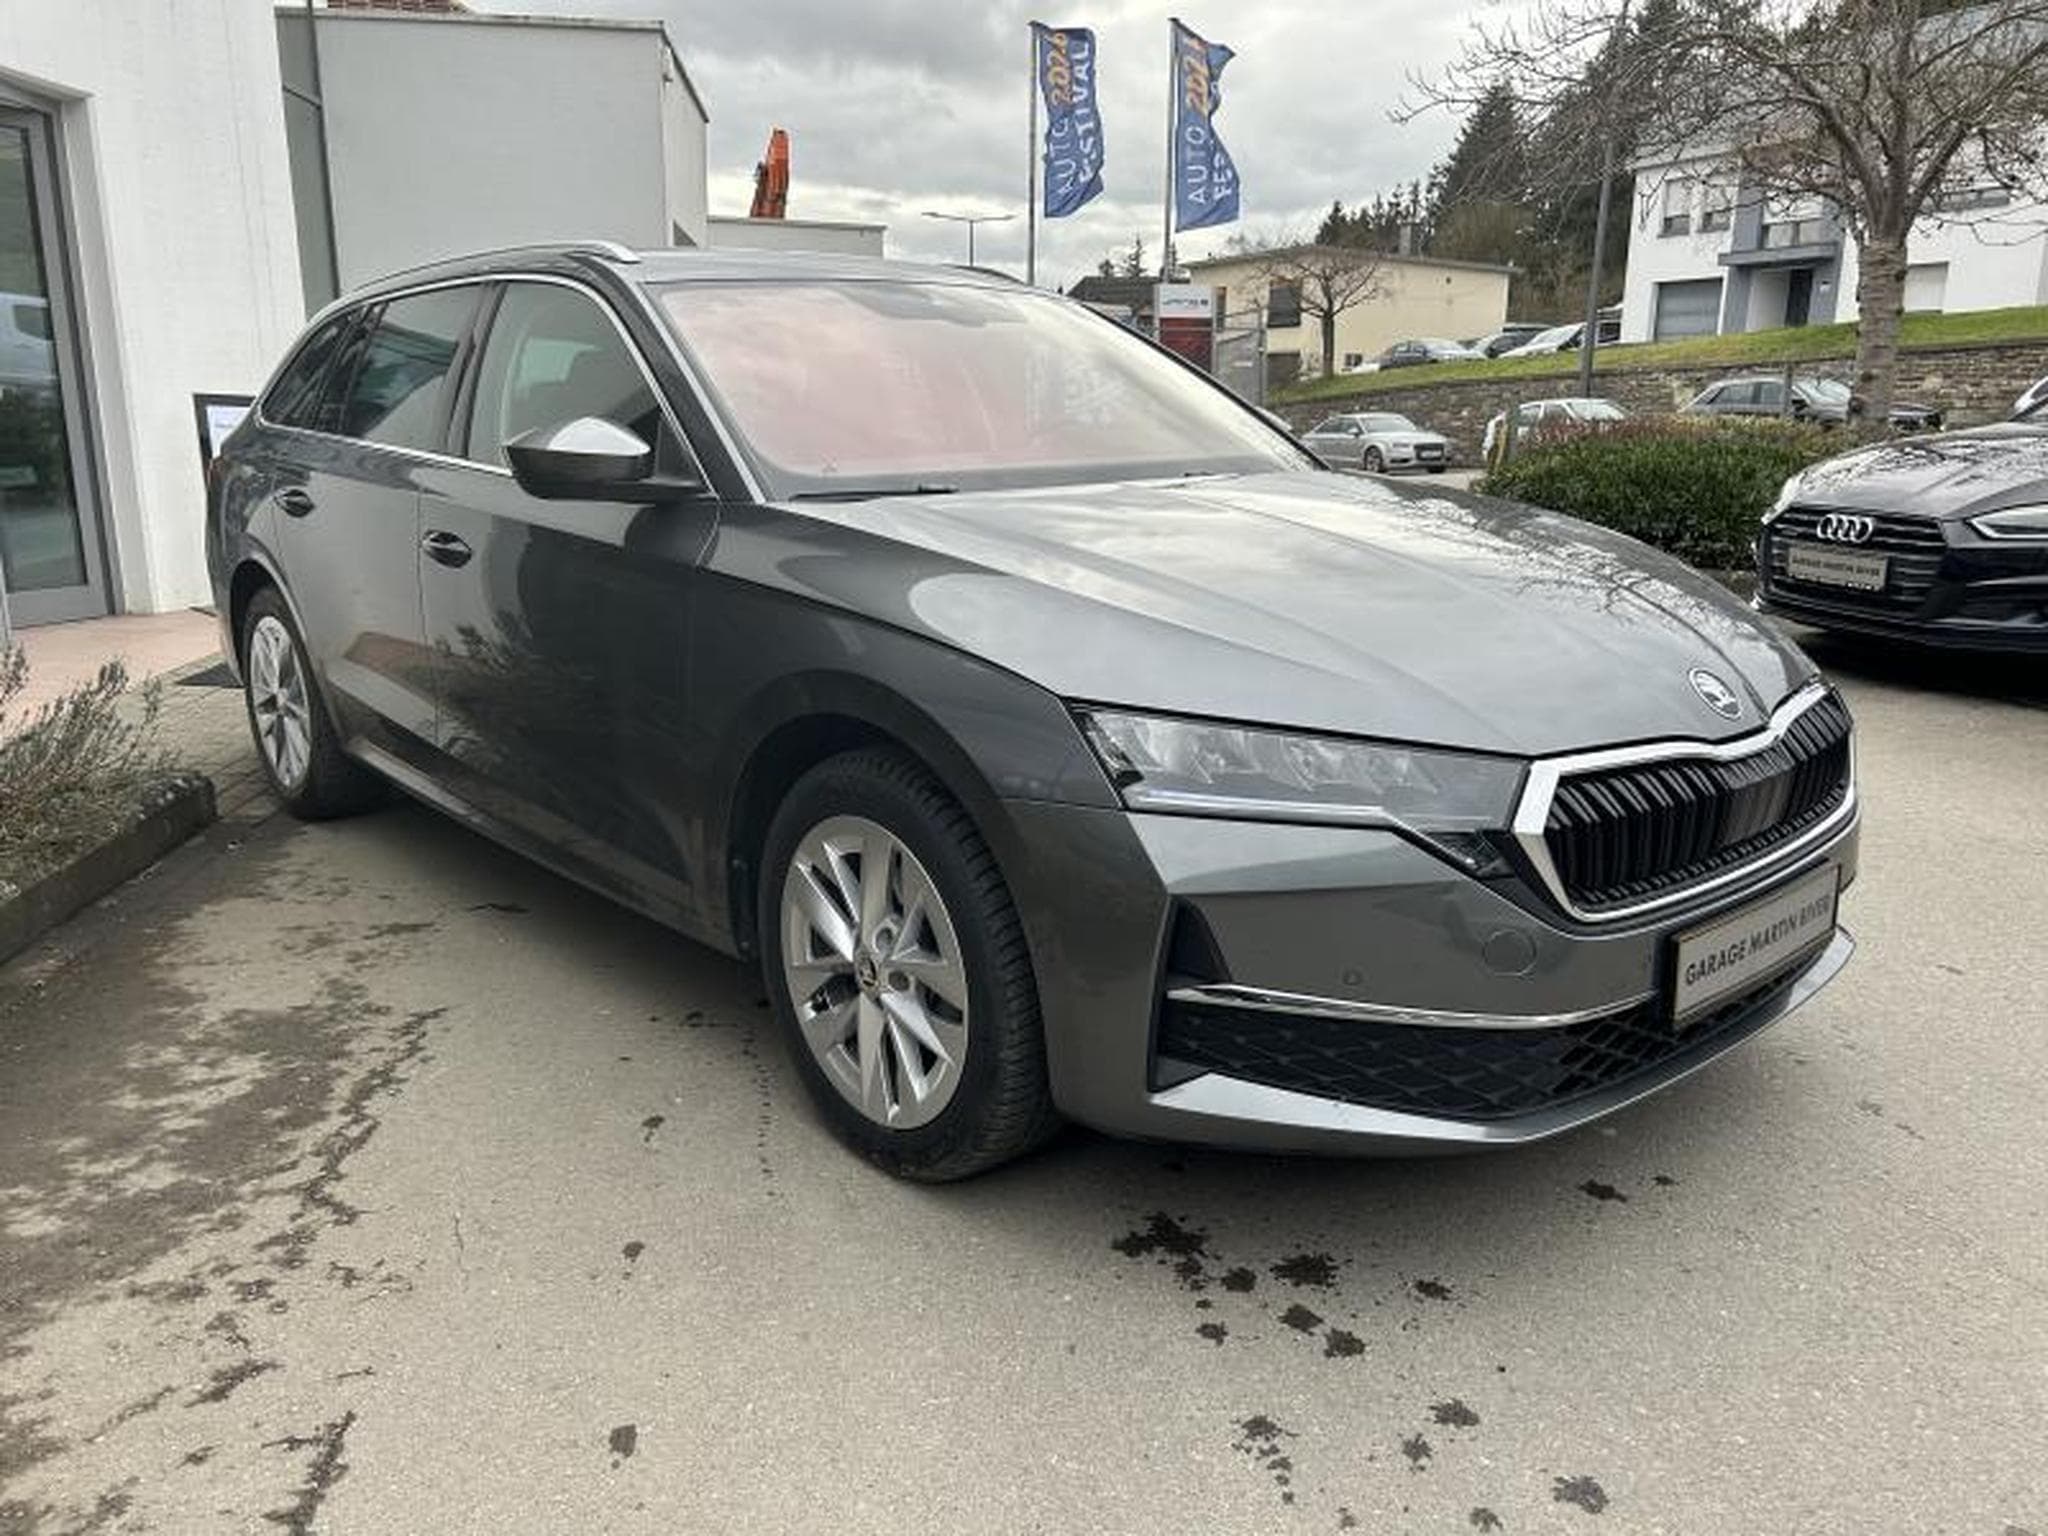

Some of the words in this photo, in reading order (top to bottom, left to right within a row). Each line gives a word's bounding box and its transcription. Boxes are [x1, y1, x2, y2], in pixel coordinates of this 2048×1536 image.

[1186, 126, 1208, 204] AUTO
[1685, 939, 1746, 986] GARAGE
[1749, 914, 1798, 955] MARTIN
